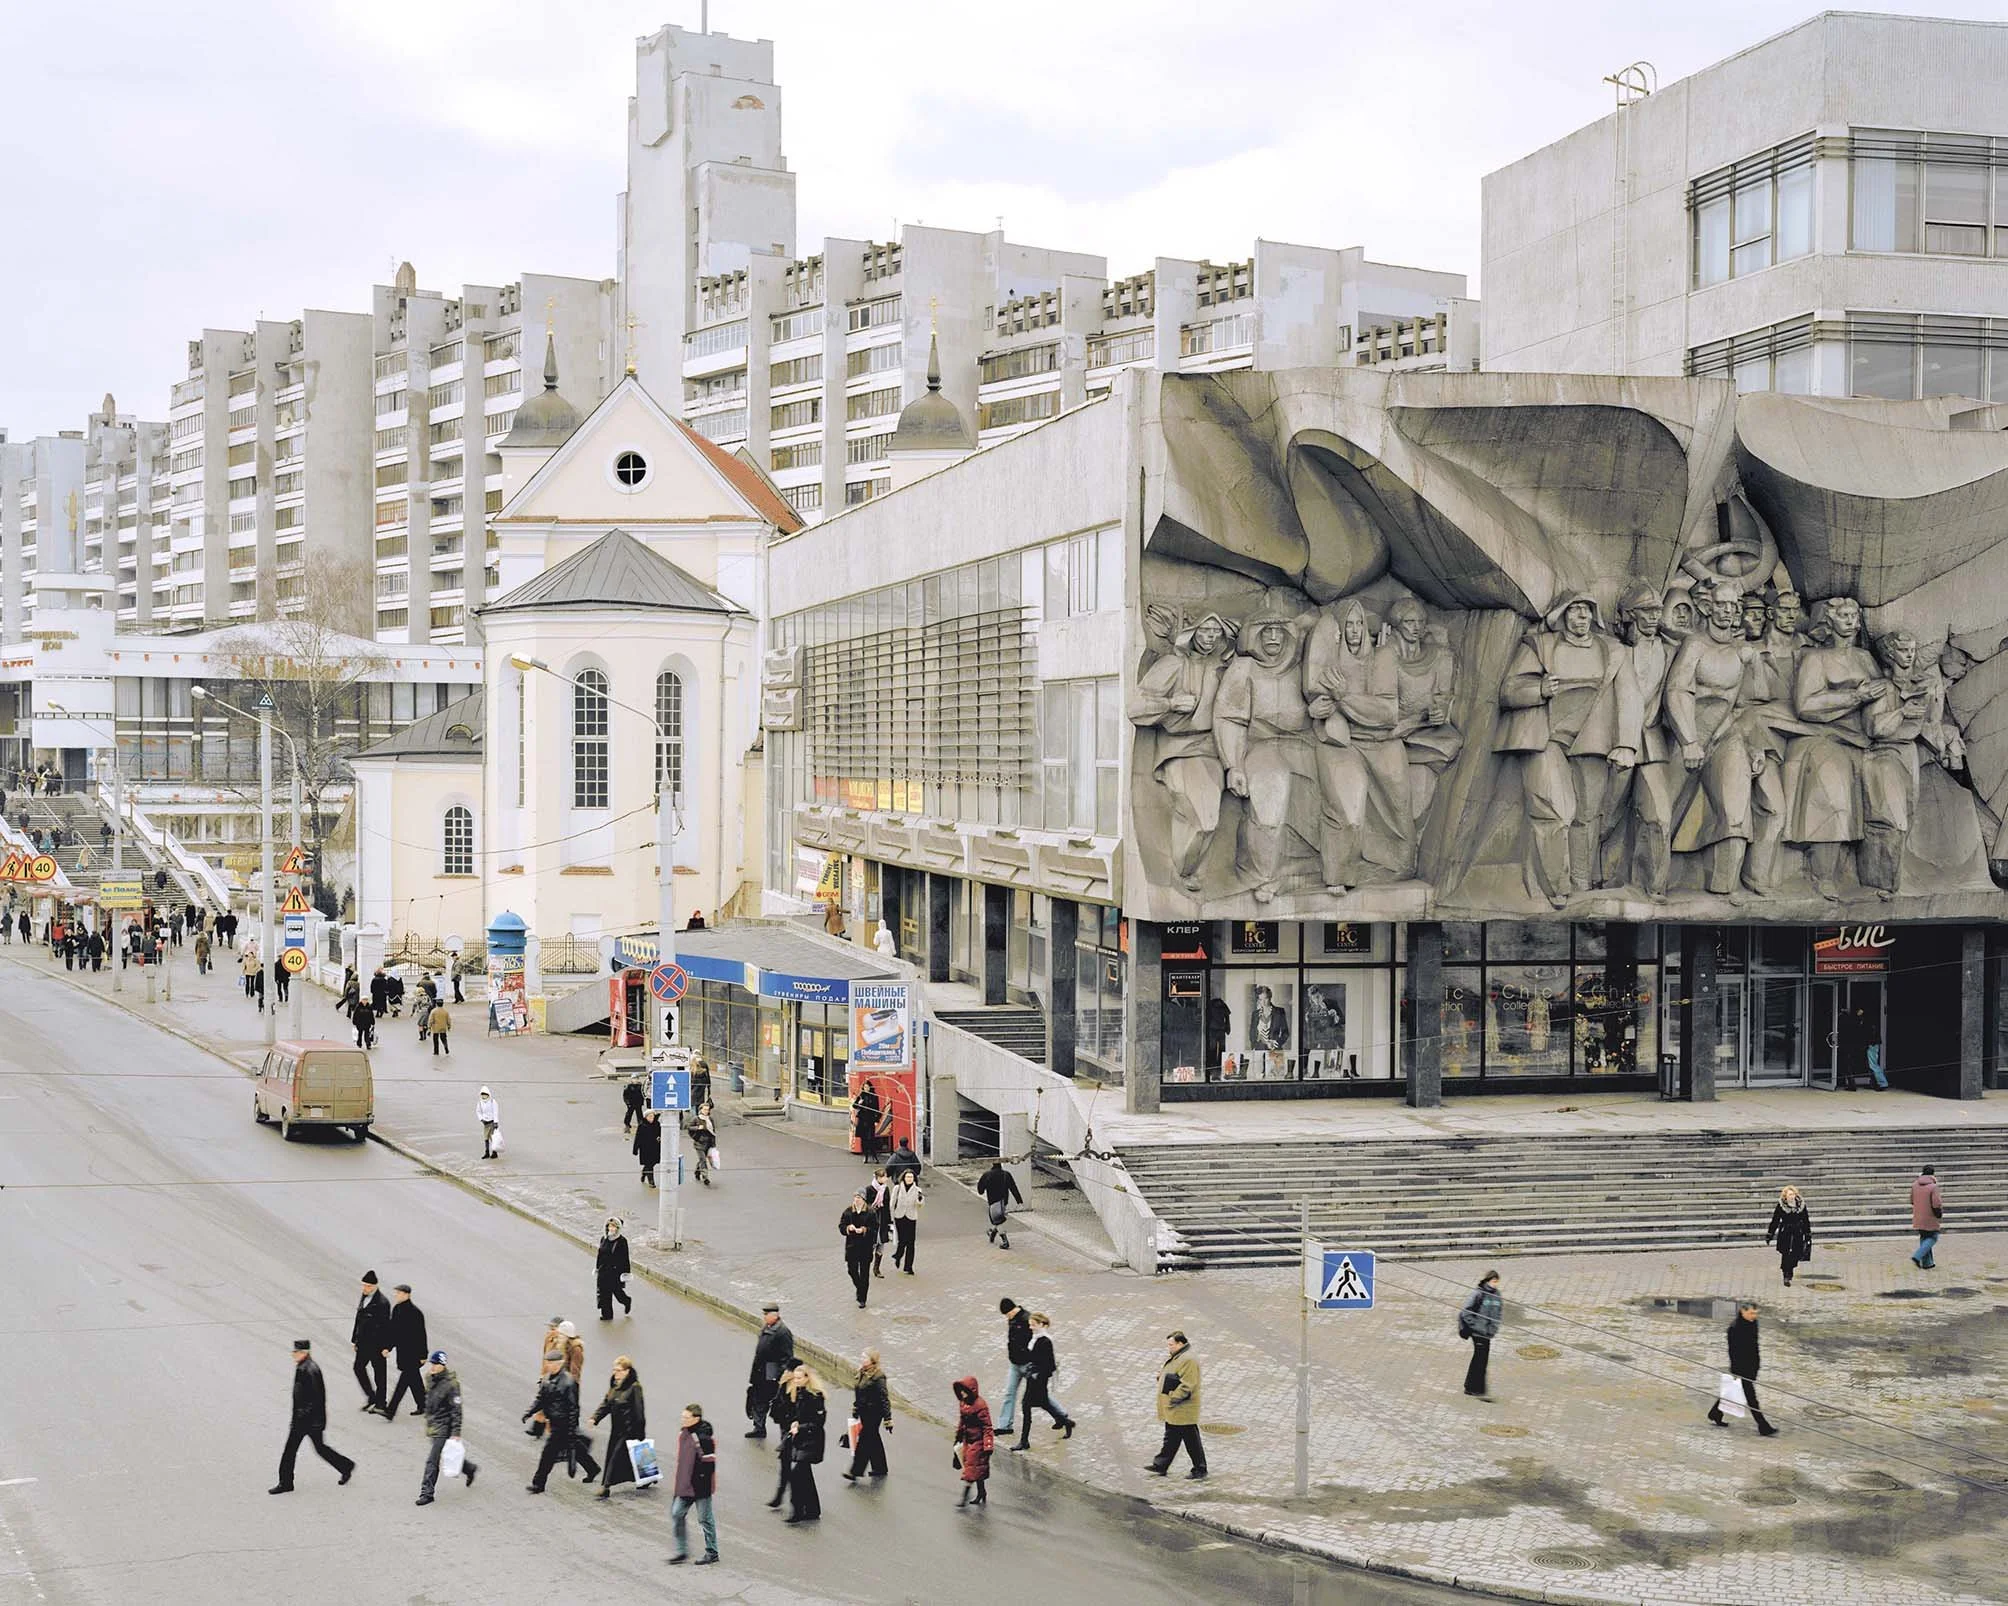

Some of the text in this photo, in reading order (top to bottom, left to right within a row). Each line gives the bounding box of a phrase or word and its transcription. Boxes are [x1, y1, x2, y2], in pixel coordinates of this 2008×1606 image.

[36, 862, 50, 873] 40
[1166, 926, 1200, 934] КЛЕР
[287, 955, 302, 966] 40
[855, 985, 906, 997] ШВЕЙНЫЕ
[1445, 984, 1464, 1000] ic
[1502, 983, 1553, 999] Chic
[855, 998, 906, 1008] МАШИНЫ
